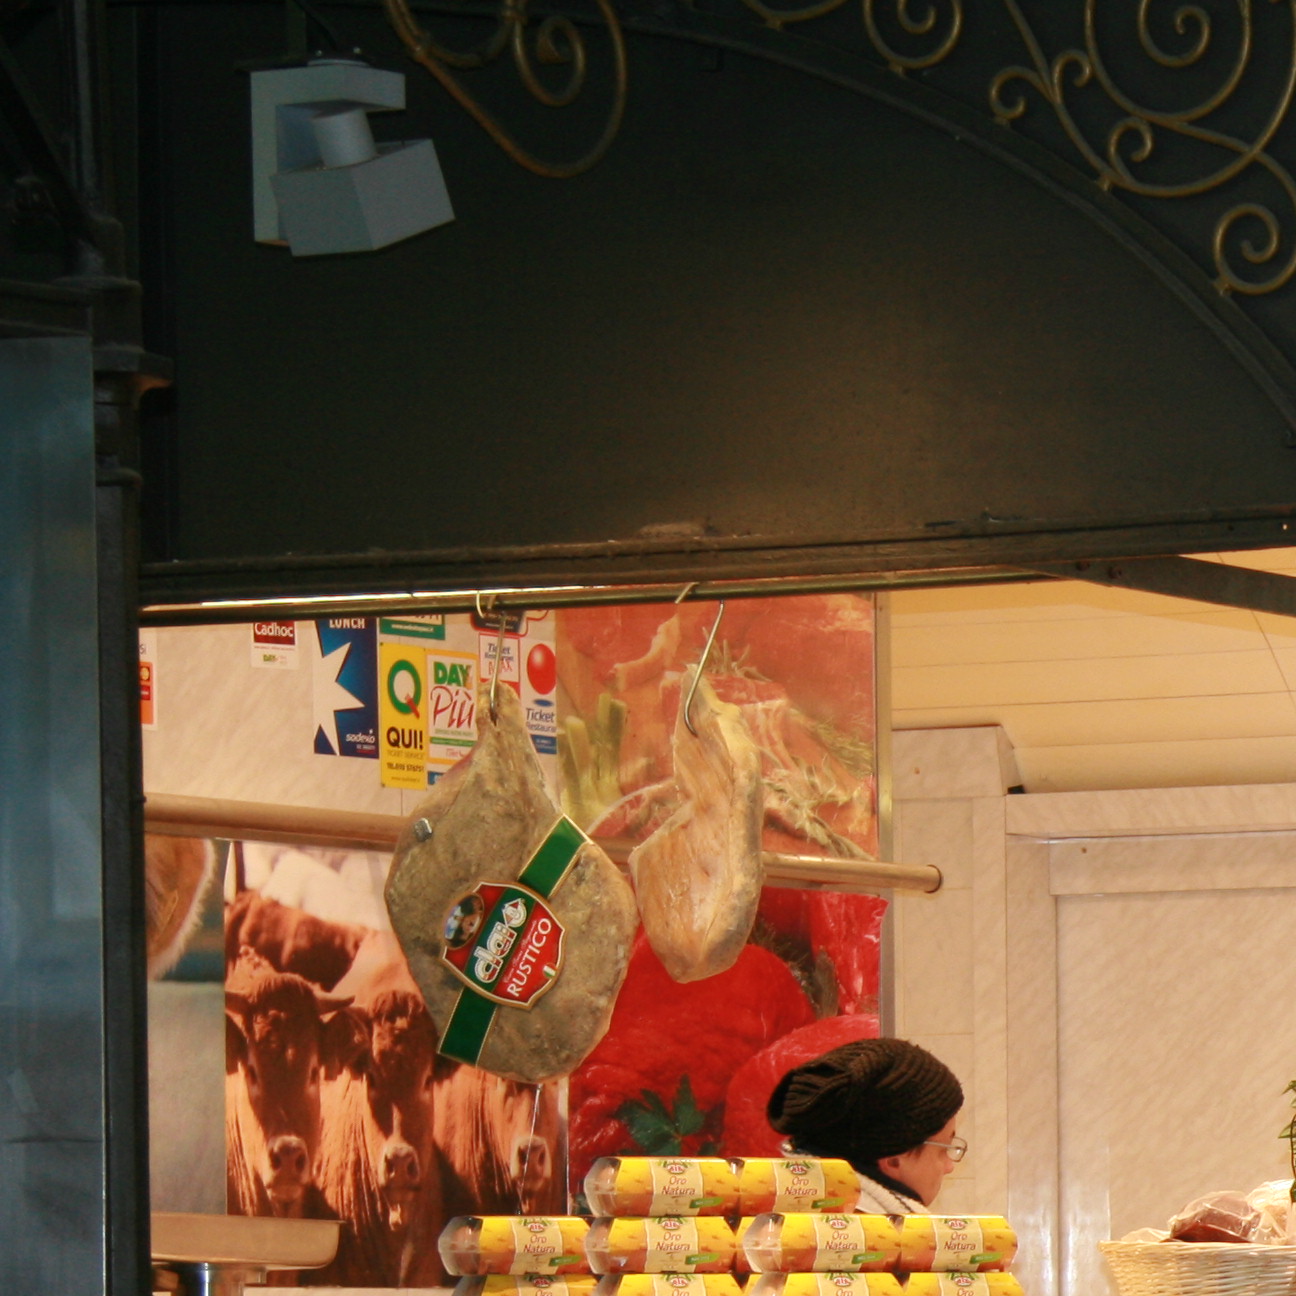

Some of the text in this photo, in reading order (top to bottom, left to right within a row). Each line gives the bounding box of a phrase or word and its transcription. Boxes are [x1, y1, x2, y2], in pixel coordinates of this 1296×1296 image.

[329, 618, 366, 629] LUNCH
[254, 622, 294, 638] Cadhoc
[433, 661, 472, 688] DAY
[430, 685, 475, 729] Più
[526, 707, 555, 723] Ticket
[386, 726, 424, 750] QUI!
[507, 918, 552, 997] RUSTICO
[669, 1176, 687, 1186] Oro
[792, 1176, 809, 1186] Oro
[661, 1185, 696, 1196] Natura
[784, 1186, 818, 1196] Natura
[530, 1234, 547, 1244] Oro
[663, 1231, 681, 1241] Oro
[832, 1230, 849, 1240] Oro
[951, 1231, 968, 1241] Oro
[523, 1243, 556, 1254] Natura
[655, 1241, 691, 1251] Natura
[825, 1240, 858, 1251] Natura
[943, 1240, 976, 1251] Natura
